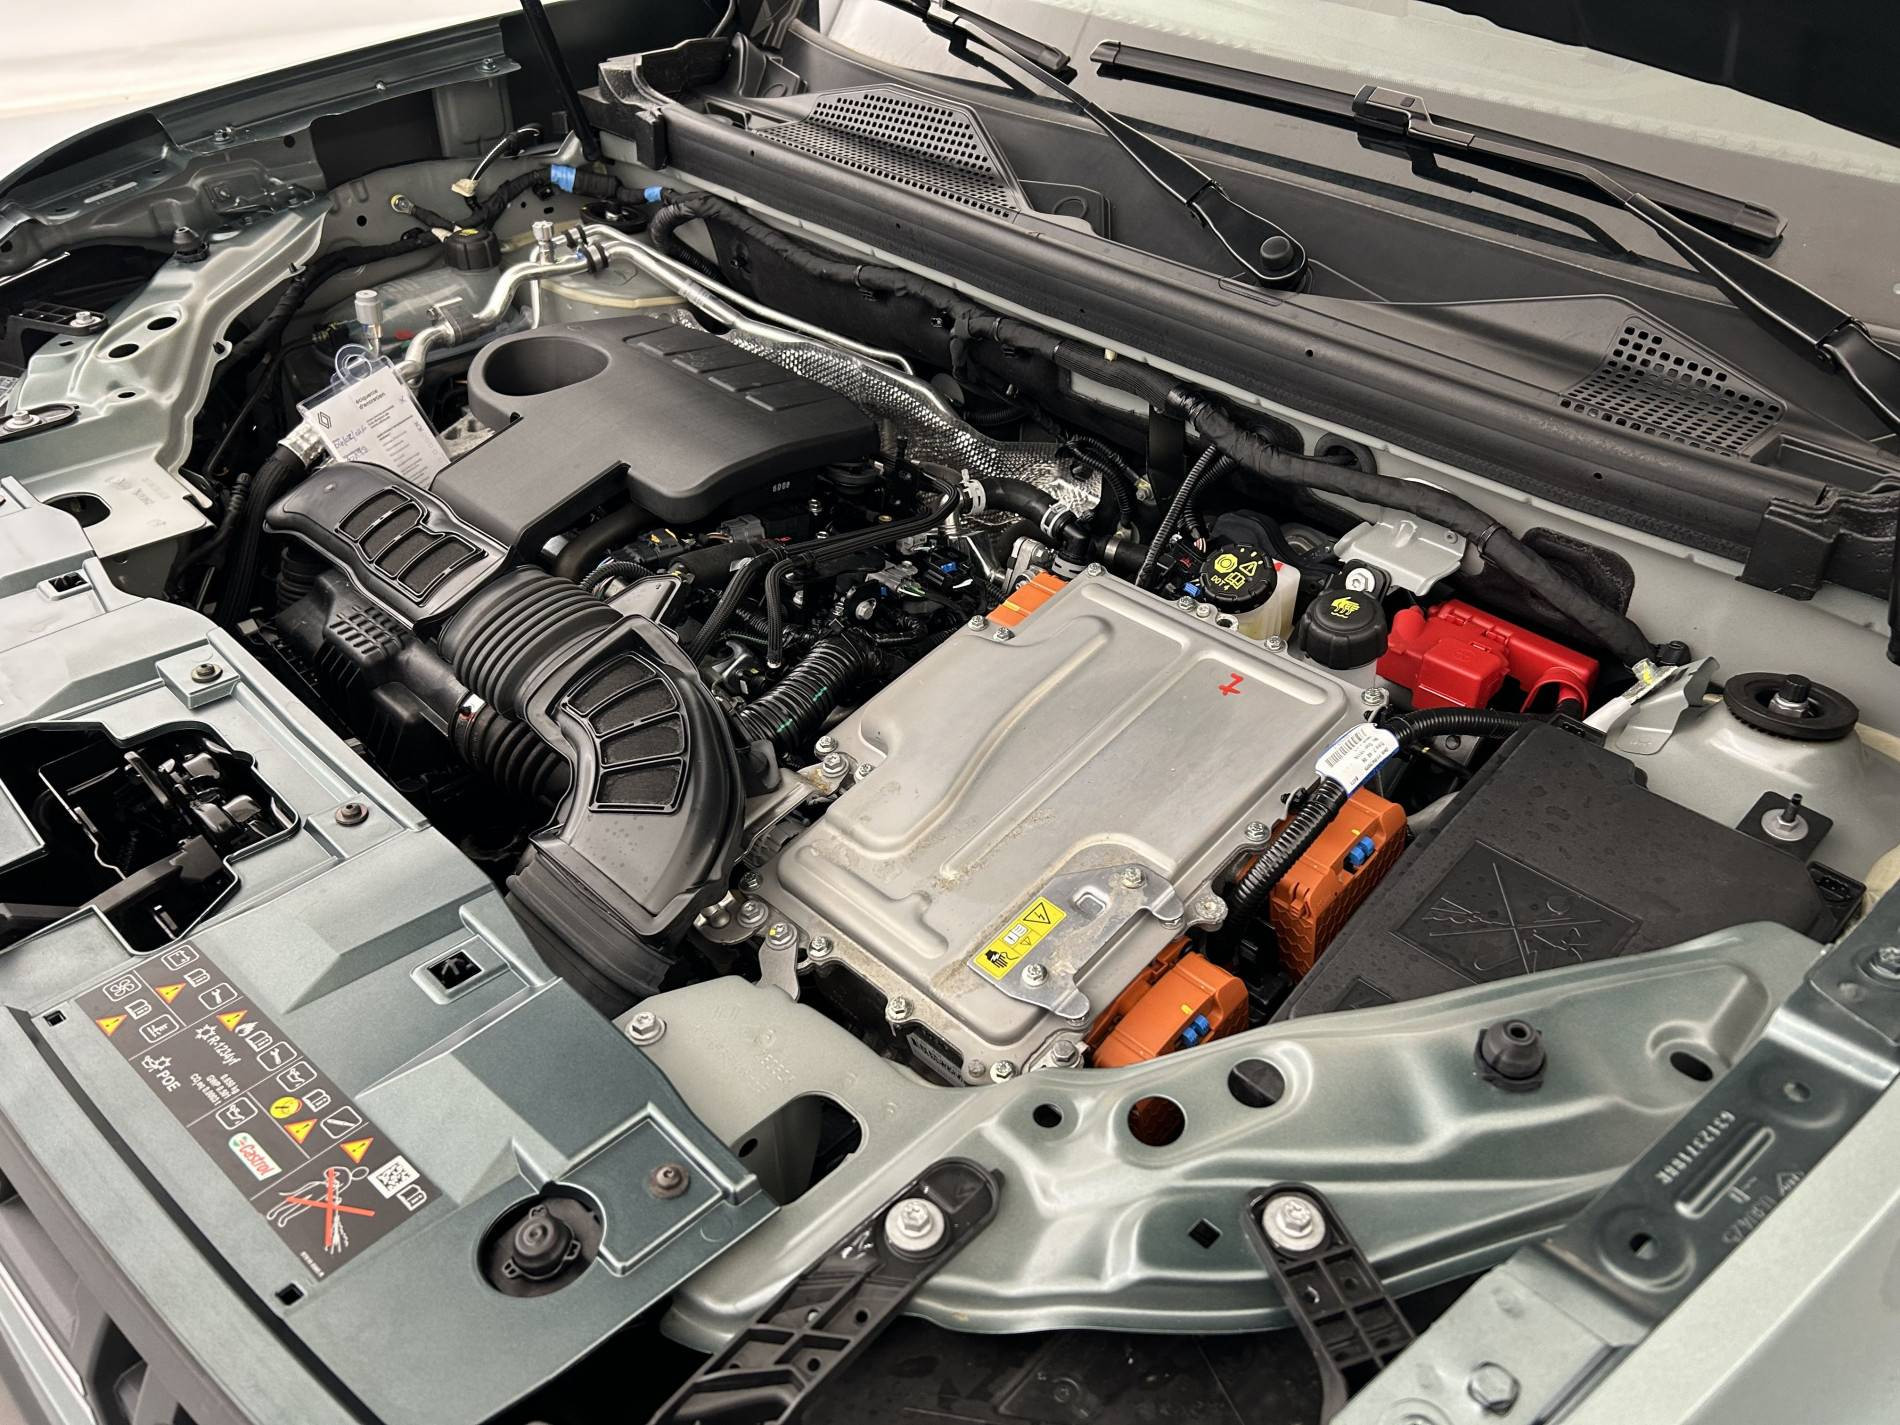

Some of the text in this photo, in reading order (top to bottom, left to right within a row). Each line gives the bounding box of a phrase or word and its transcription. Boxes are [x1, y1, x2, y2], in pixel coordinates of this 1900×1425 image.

[1210, 574, 1226, 587] DOT
[156, 1069, 181, 1093] POE
[239, 1144, 275, 1176] Castrol
